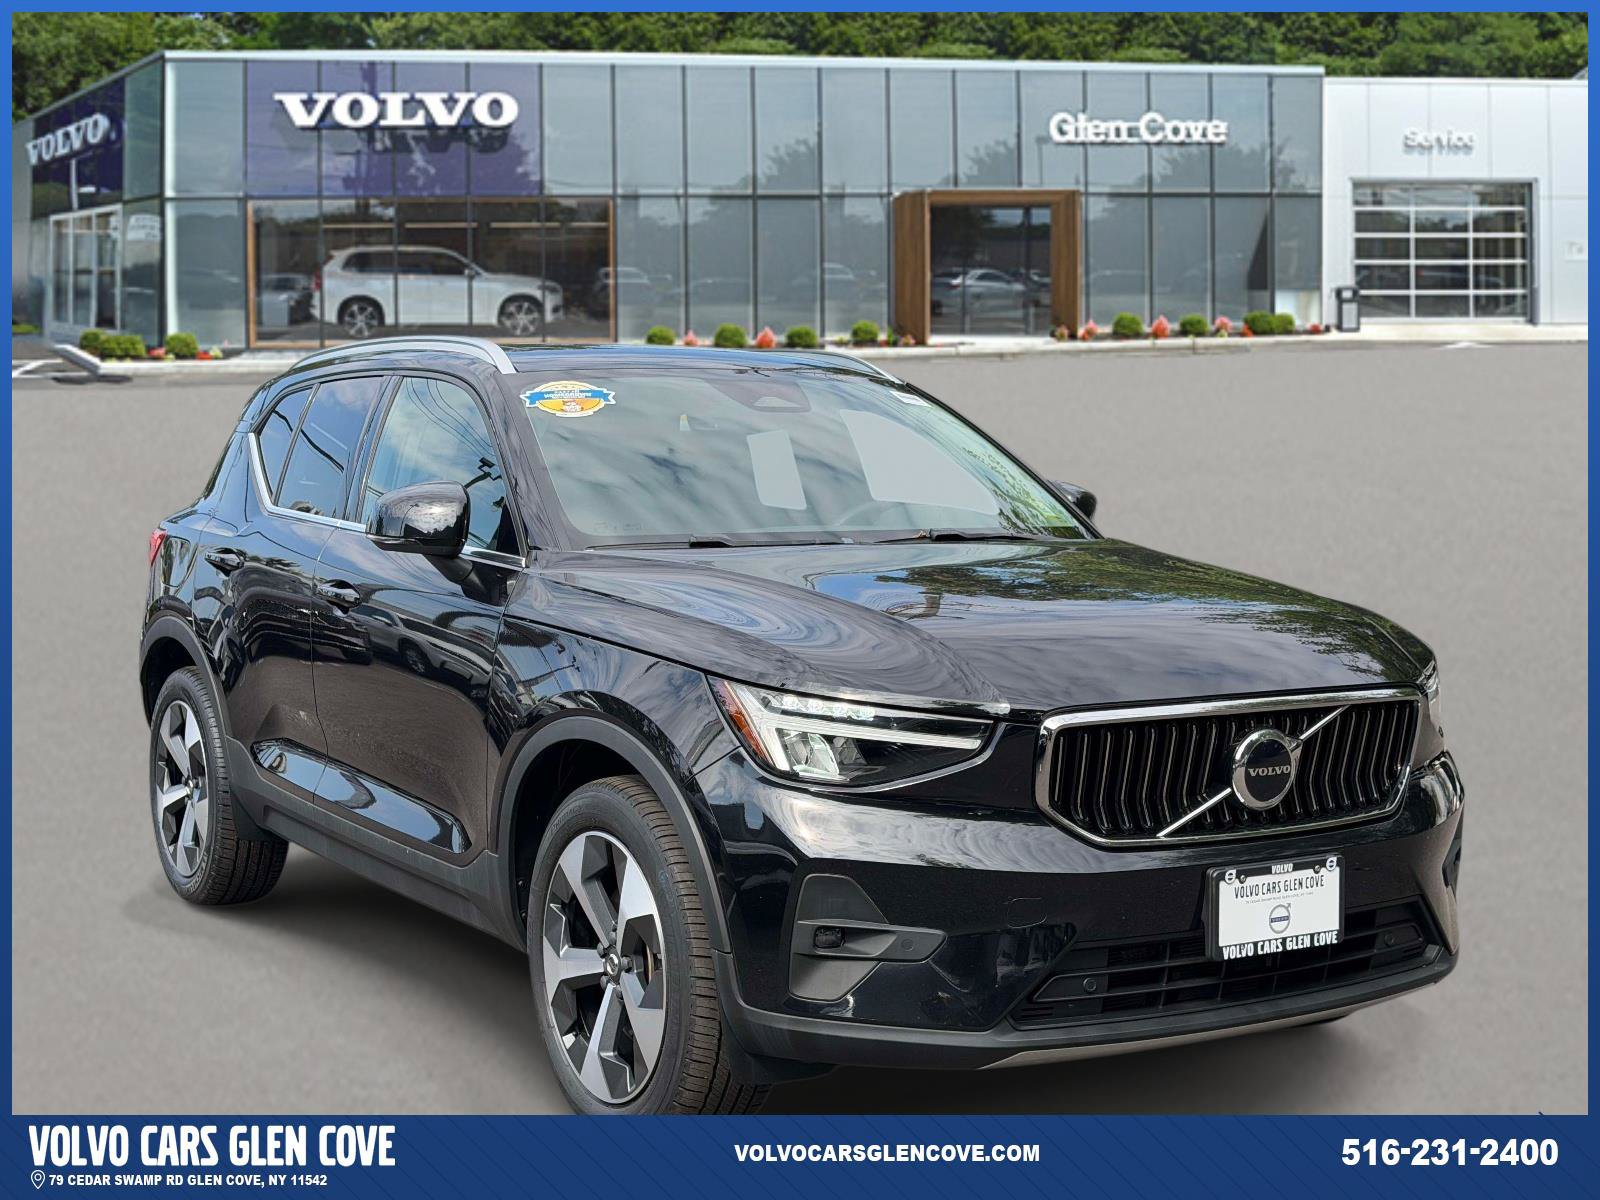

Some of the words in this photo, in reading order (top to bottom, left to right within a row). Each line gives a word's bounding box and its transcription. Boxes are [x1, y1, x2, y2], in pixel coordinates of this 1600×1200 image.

[274, 92, 520, 128] VOLVO
[26, 113, 111, 166] VOLVO
[1049, 112, 1128, 144] Glen
[1140, 112, 1228, 144] Cove
[1403, 128, 1476, 152] Service
[1248, 765, 1291, 777] VOLVO
[1271, 863, 1294, 875] VOLVO
[1234, 881, 1260, 899] VOLVO
[1261, 880, 1282, 895] CARS
[1284, 877, 1303, 892] GLEN
[1305, 874, 1325, 890] COVE
[1222, 942, 1254, 960] VOLVO
[1257, 938, 1283, 955] CARS
[1286, 934, 1311, 951] GLEN
[1313, 930, 1338, 947] COVE
